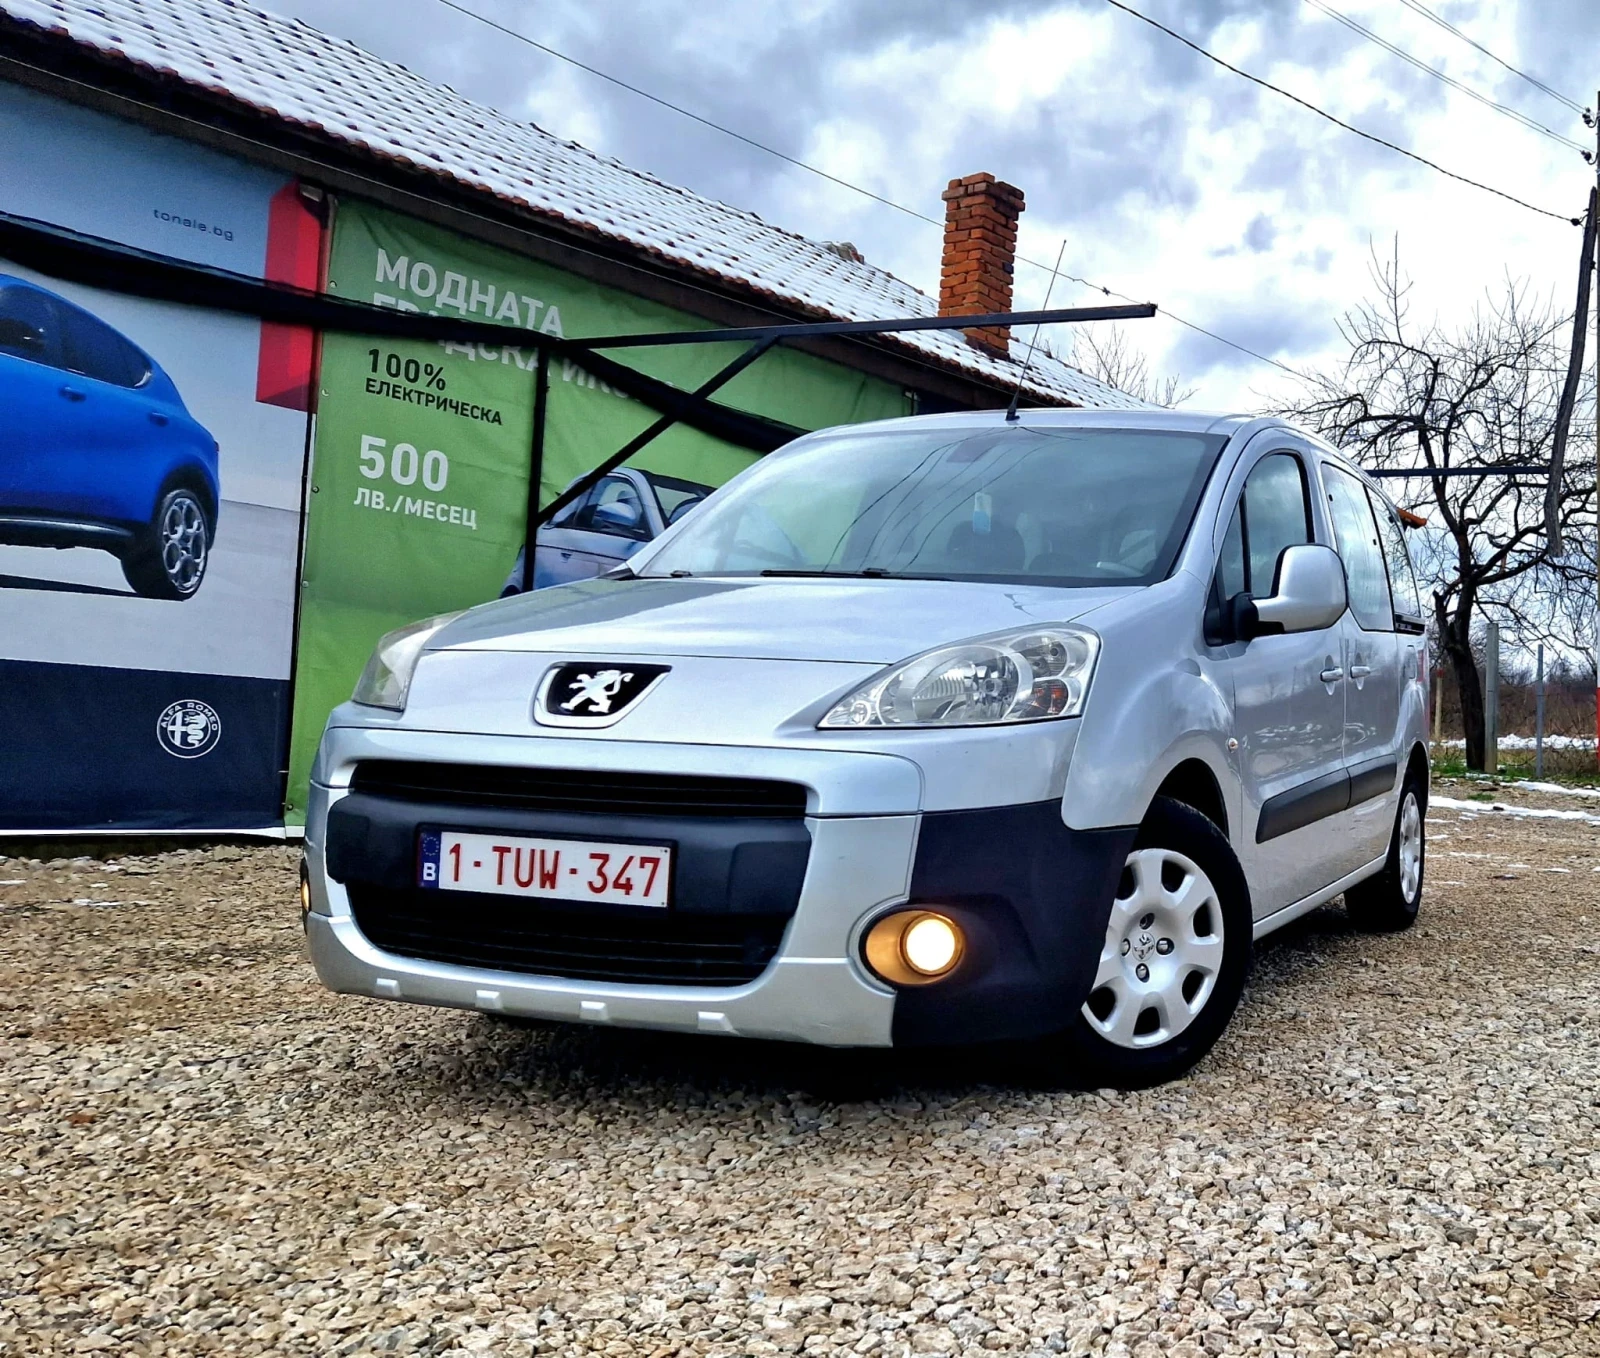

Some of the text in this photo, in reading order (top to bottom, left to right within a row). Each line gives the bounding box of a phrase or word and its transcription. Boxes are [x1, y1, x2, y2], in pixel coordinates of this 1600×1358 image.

[153, 209, 234, 242] tonale.bg
[375, 248, 565, 340] МОДНАТА
[368, 349, 447, 391] 100%
[365, 377, 503, 426] ЕЛЕКТРИЧЕСКА
[359, 434, 449, 492] 500
[353, 487, 478, 530] ЛВ./МЕСЕЦ
[160, 702, 218, 731] ALFA ROMEO
[423, 862, 437, 881] B
[449, 843, 661, 897] 1-TUW-347
